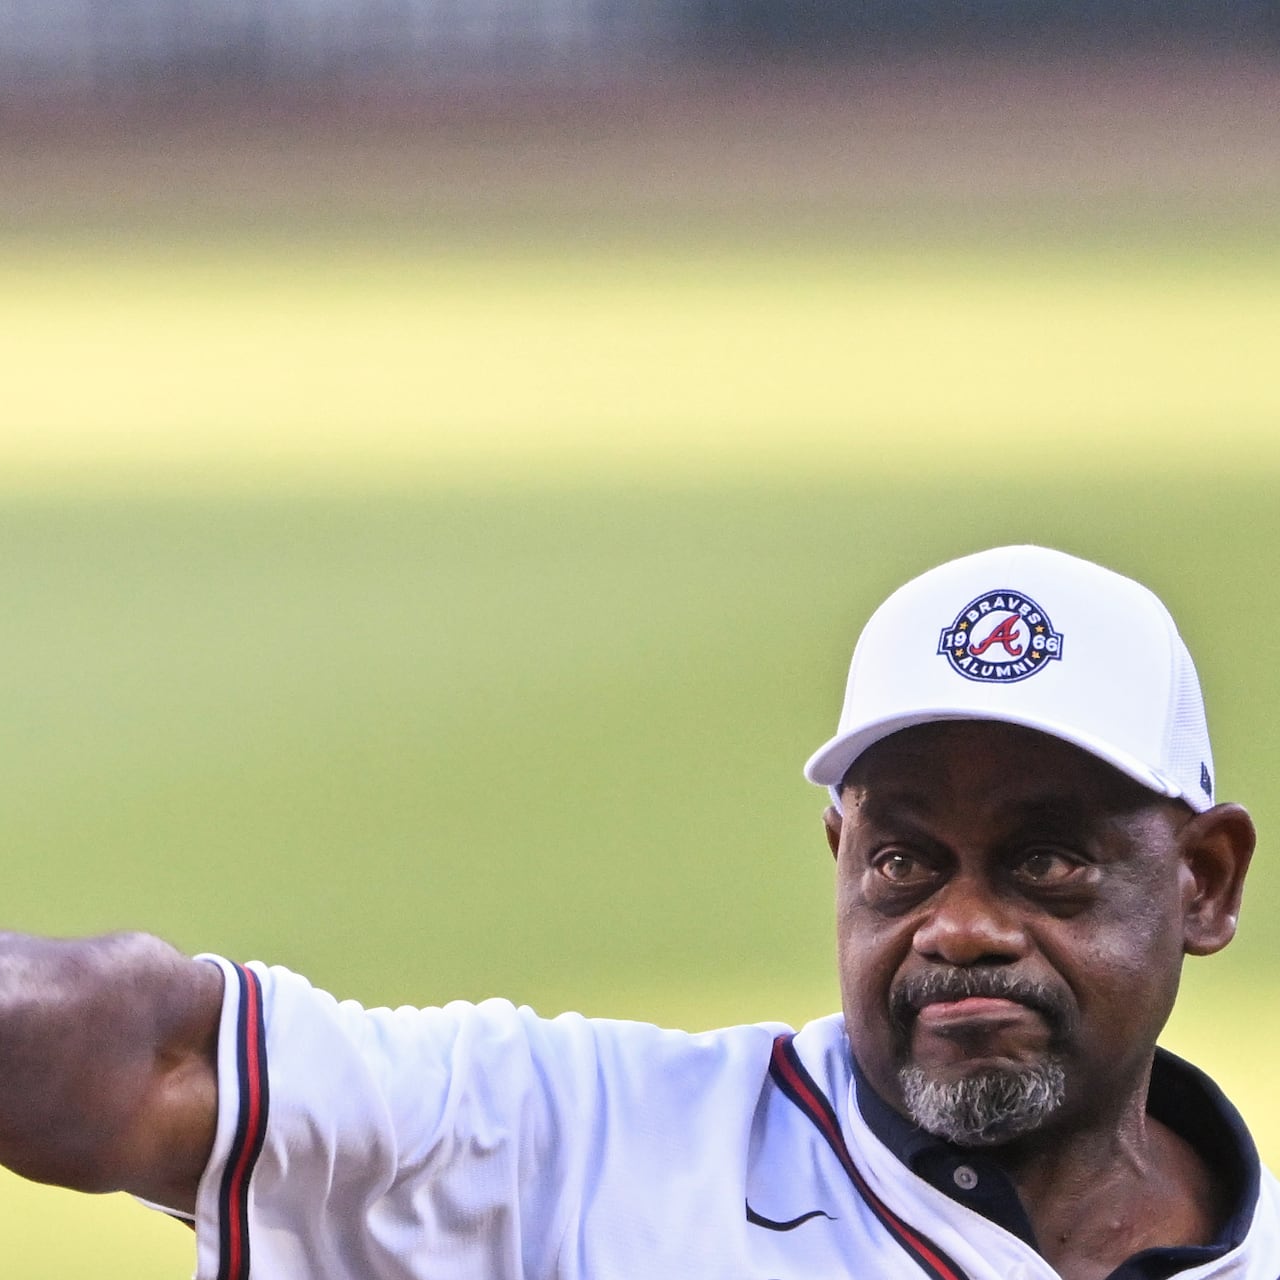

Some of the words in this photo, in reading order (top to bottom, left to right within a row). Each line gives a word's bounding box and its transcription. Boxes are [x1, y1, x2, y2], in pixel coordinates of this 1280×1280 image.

[966, 596, 1042, 625] BRAVES
[945, 631, 967, 648] 19
[1032, 634, 1059, 652] 66
[958, 656, 1036, 678] ALUMNI
